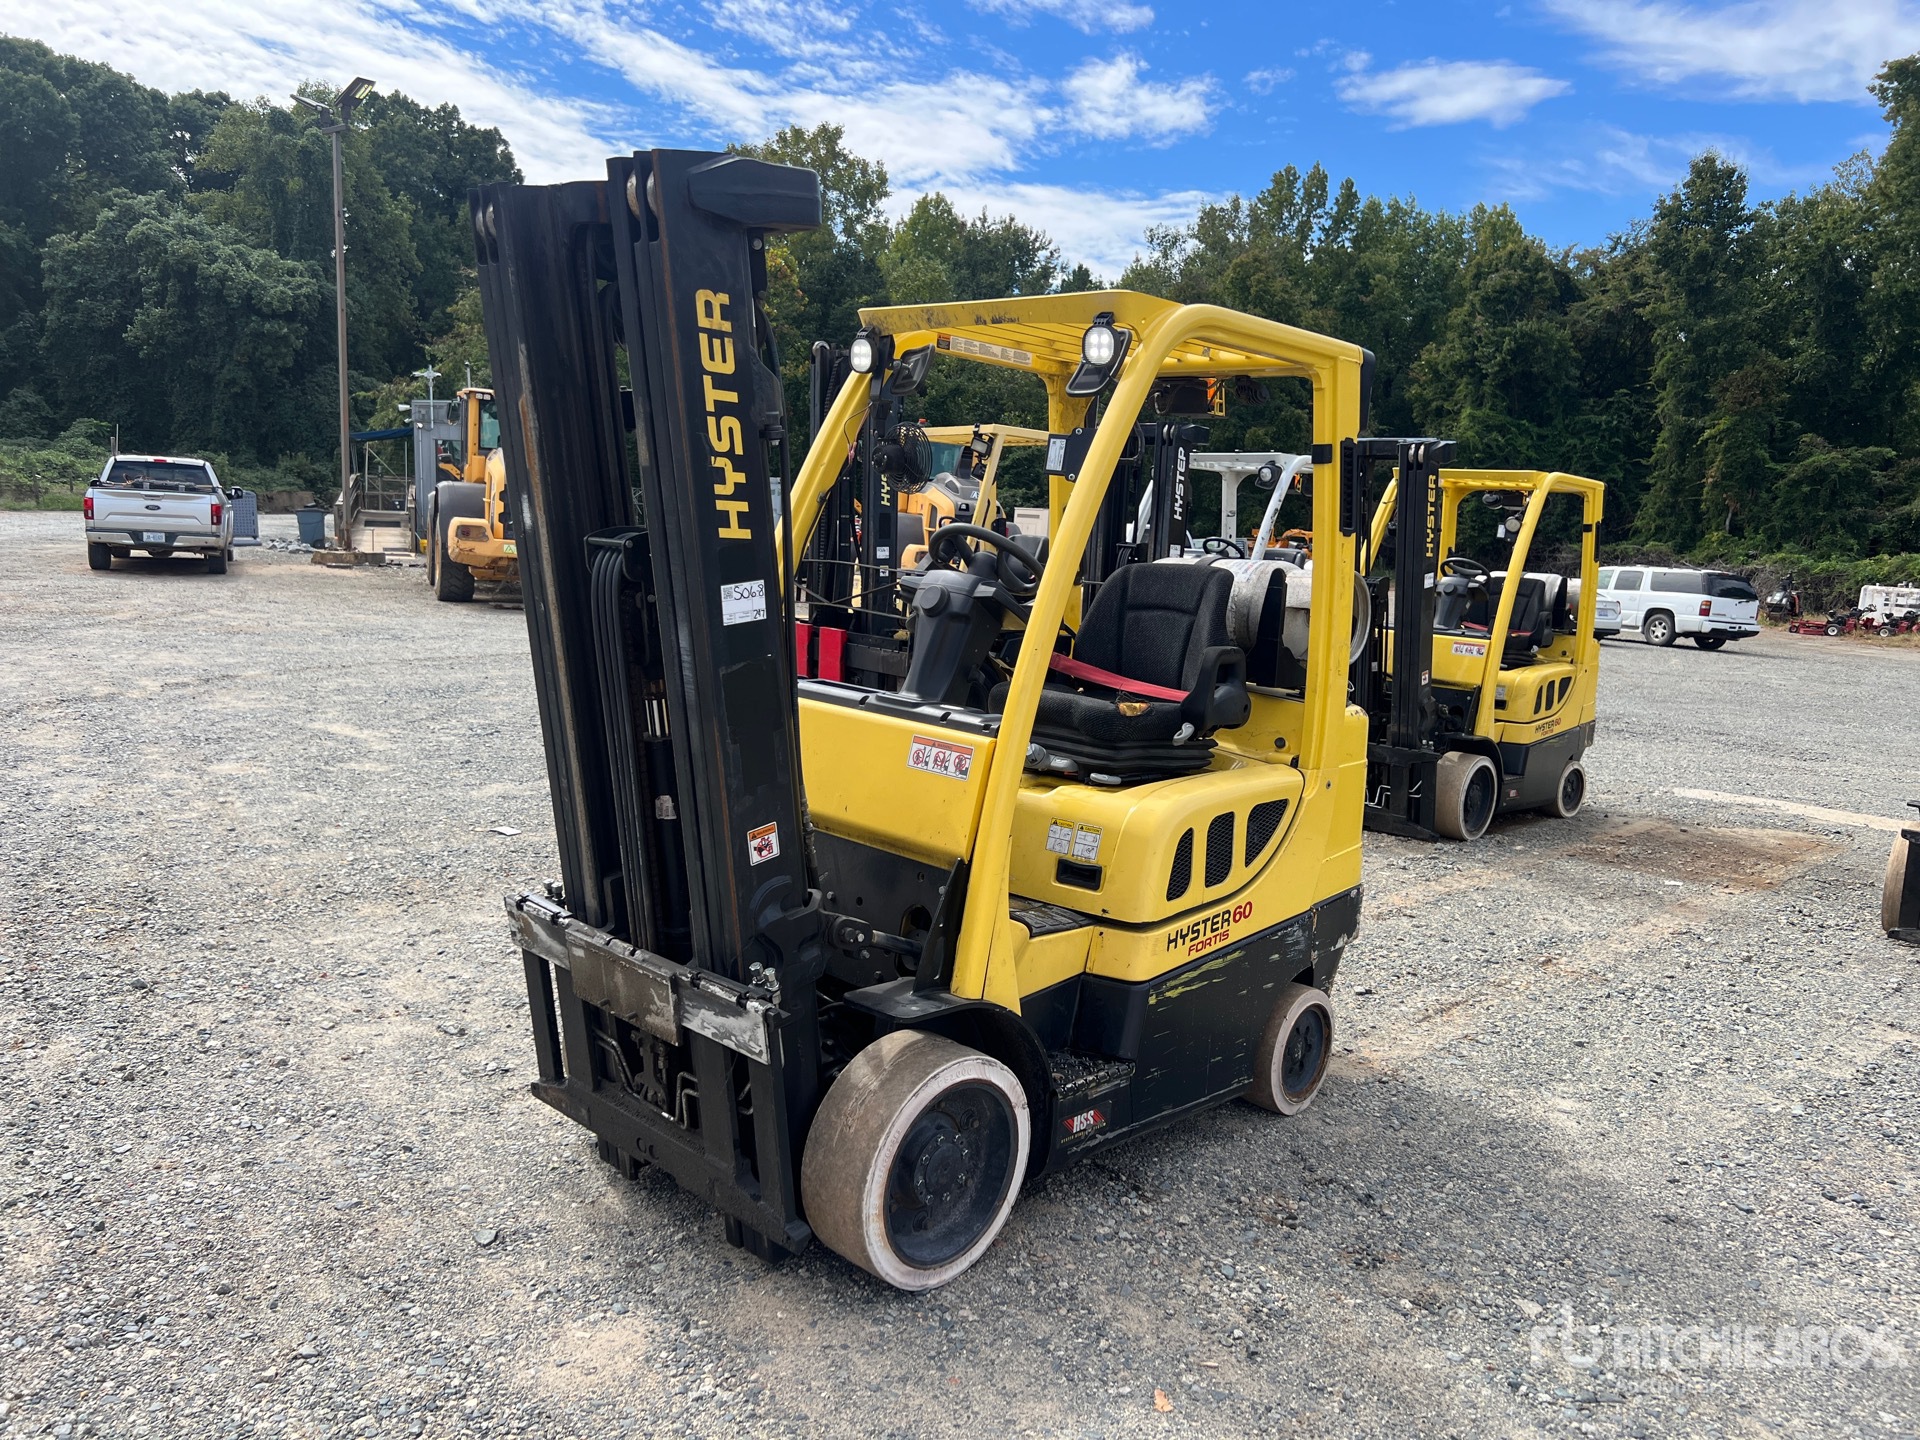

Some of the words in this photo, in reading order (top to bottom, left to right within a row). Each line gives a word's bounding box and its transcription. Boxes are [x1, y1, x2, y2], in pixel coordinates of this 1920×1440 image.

[695, 288, 752, 540] HYSTER
[1425, 474, 1437, 558] HYSTER
[1166, 909, 1232, 952] HYSTER
[1232, 901, 1253, 924] 60
[1187, 929, 1230, 957] FORTIS
[1072, 1109, 1095, 1134] HSS
